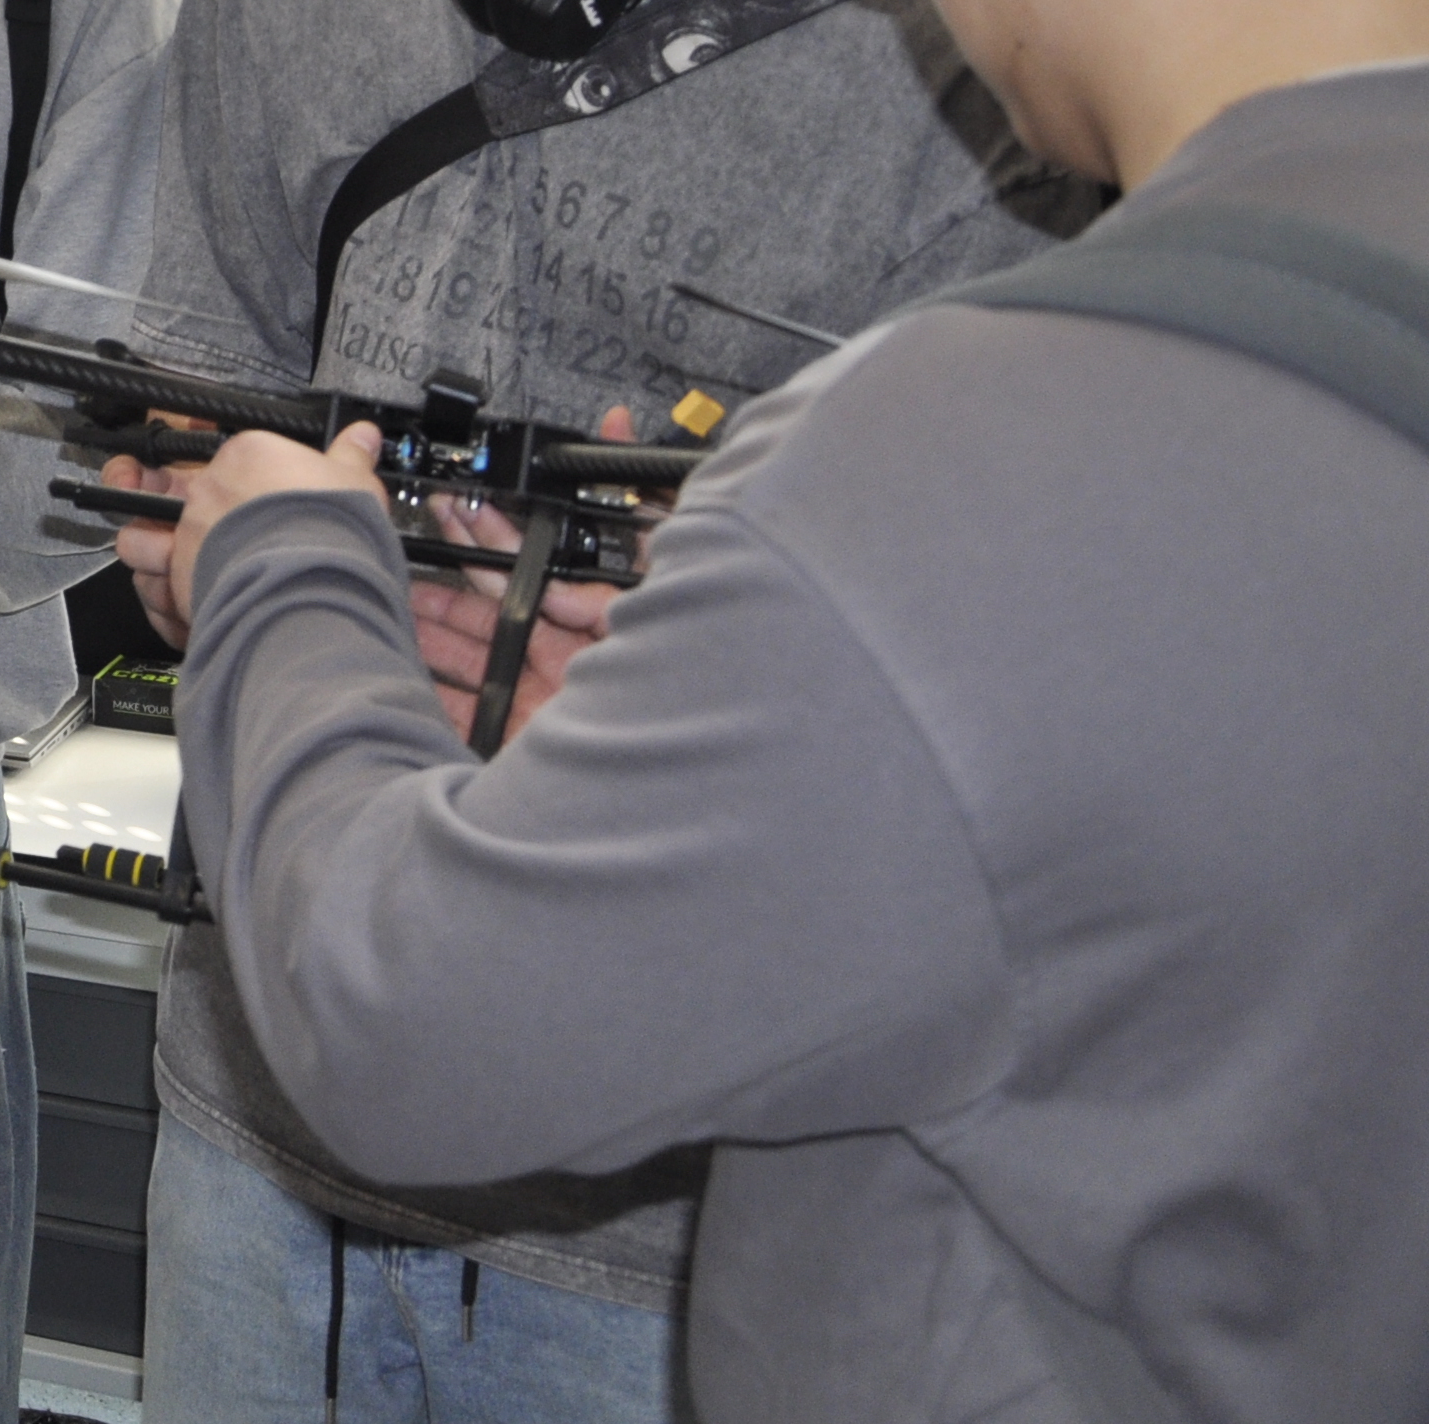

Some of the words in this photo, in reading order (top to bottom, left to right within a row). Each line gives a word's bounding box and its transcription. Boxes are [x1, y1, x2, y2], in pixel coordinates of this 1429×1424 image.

[557, 179, 587, 229] 6
[596, 191, 631, 241] 7
[642, 208, 673, 260] 8
[425, 266, 477, 320] 19
[564, 329, 628, 383] 22
[580, 260, 627, 316] 15
[641, 285, 689, 345] 16
[112, 700, 140, 712] MAKE
[142, 704, 169, 716] YOUR
